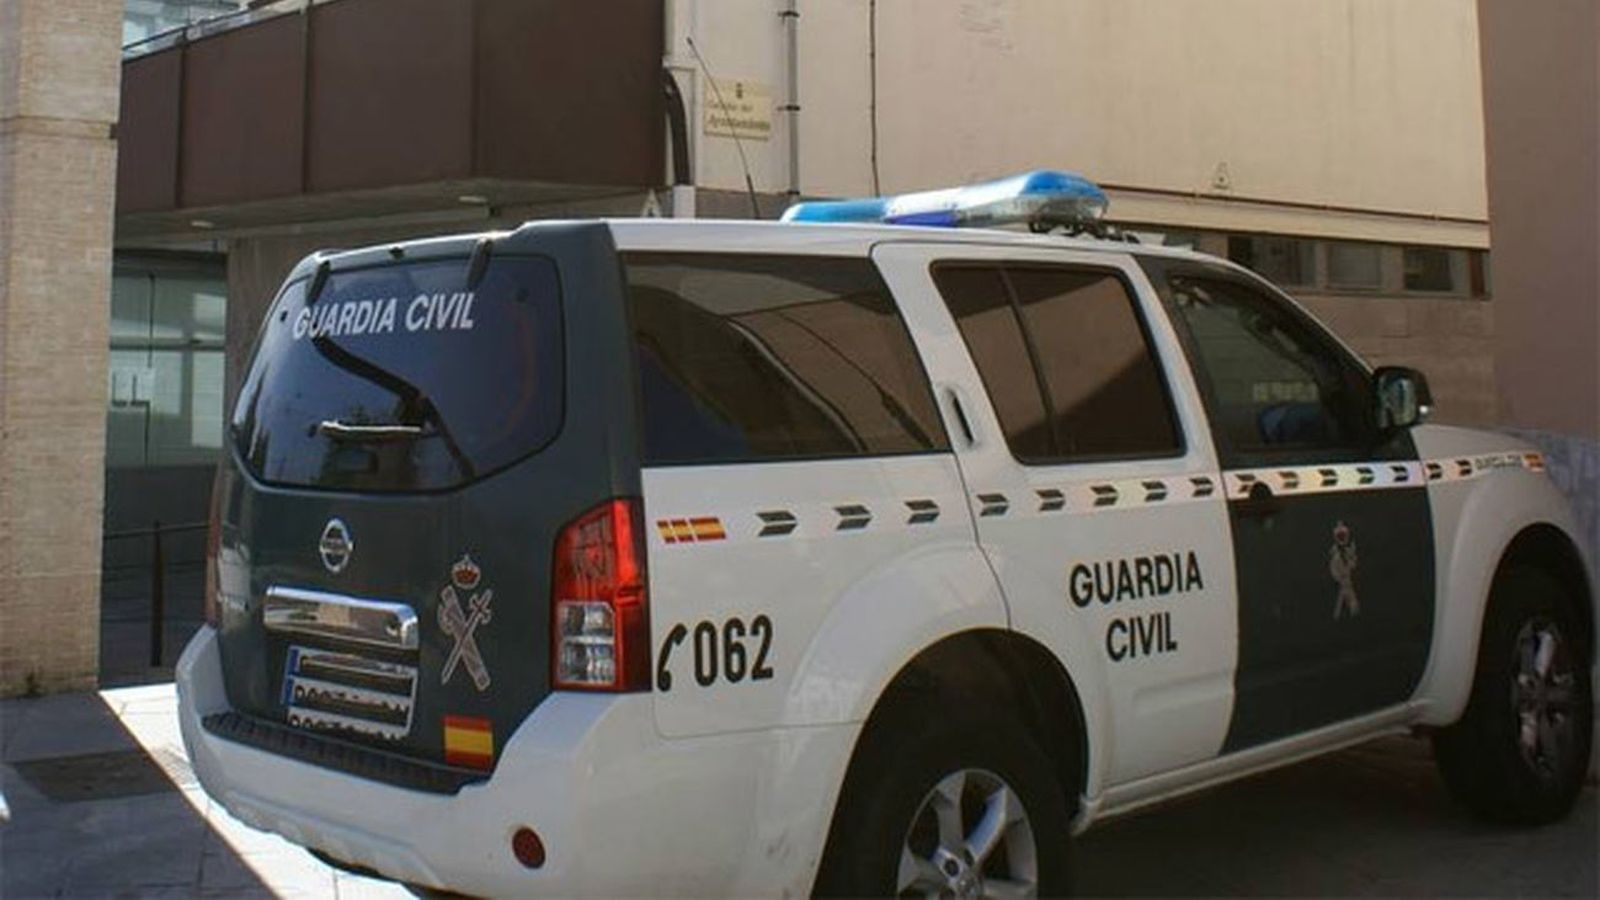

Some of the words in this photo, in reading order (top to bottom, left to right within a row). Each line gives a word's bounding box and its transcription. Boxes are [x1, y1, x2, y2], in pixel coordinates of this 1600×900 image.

[294, 298, 396, 339] GUARDIA
[405, 292, 475, 331] CIVIL
[1070, 551, 1204, 608] GUARDIA
[694, 614, 774, 687] 062
[1106, 612, 1178, 662] CIVIL
